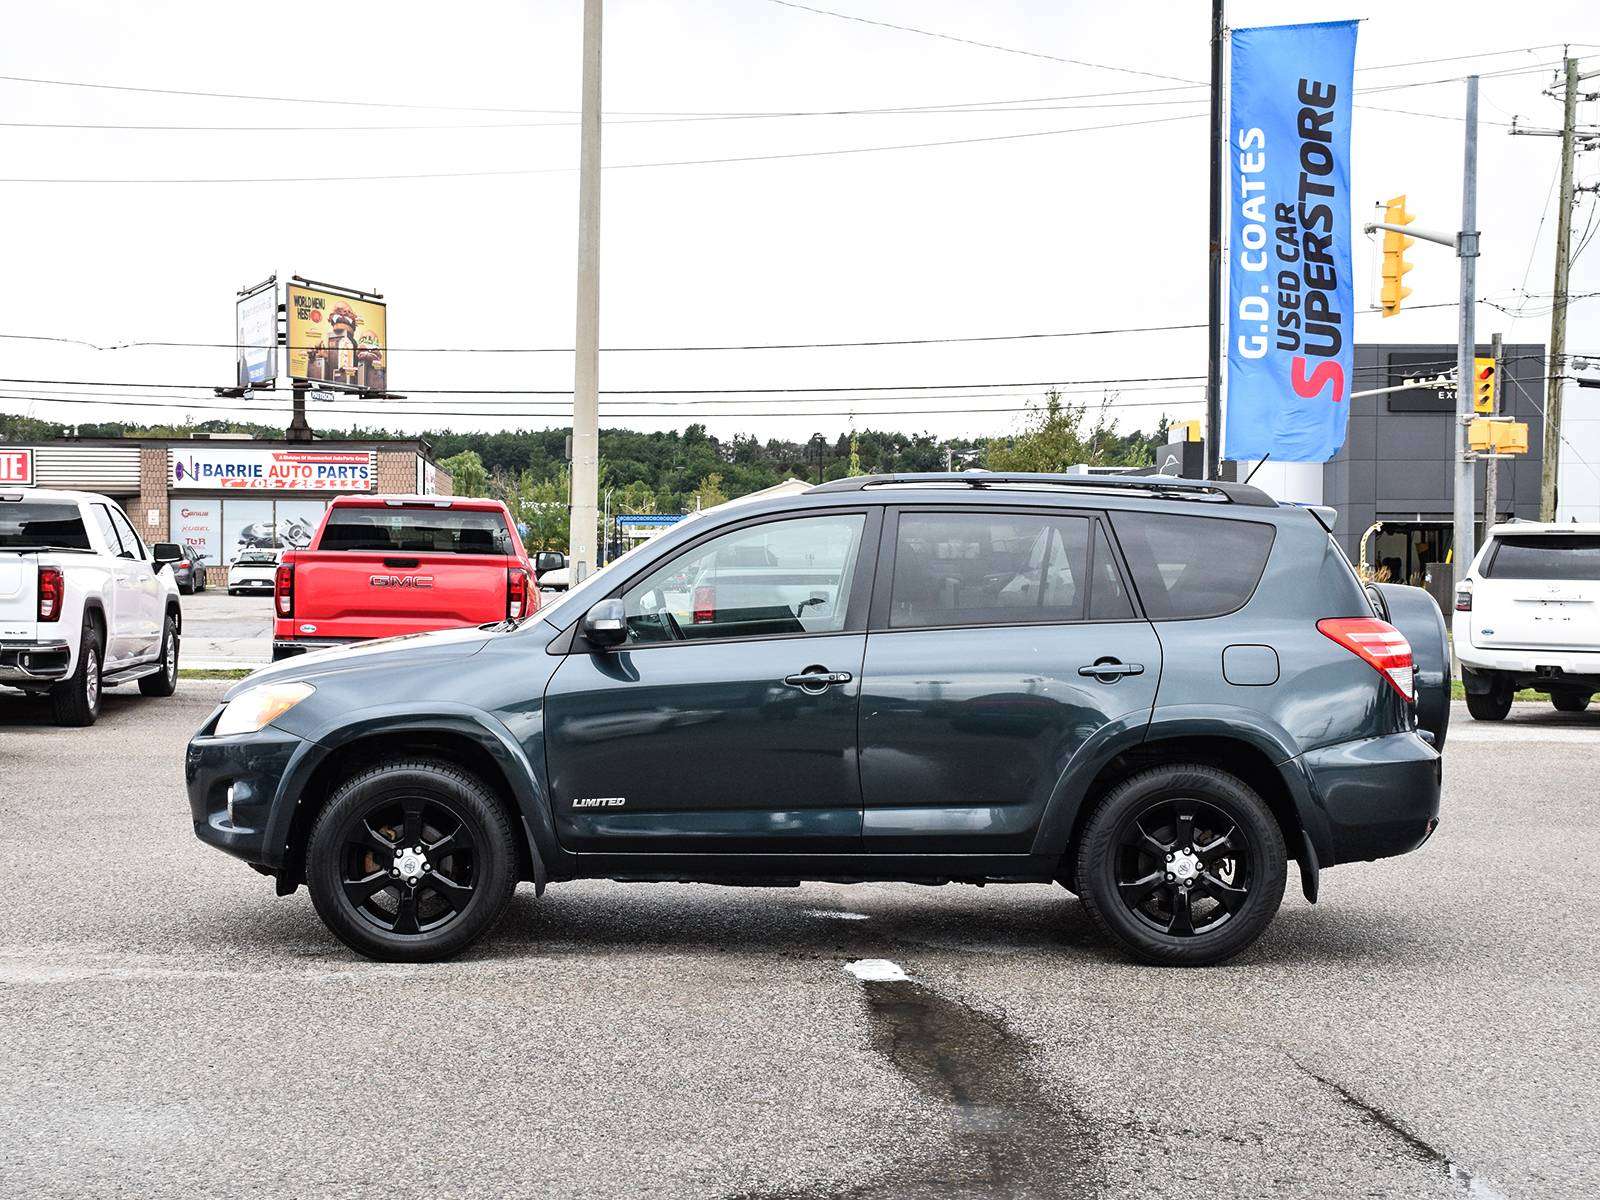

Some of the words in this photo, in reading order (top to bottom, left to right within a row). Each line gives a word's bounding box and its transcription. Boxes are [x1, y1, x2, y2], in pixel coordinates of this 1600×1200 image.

[1239, 127, 1268, 272] COATES
[1275, 202, 1300, 263] CAR
[1291, 78, 1345, 402] SUPERSTORE
[294, 295, 312, 308] WORLD
[312, 297, 326, 311] MENU
[1238, 284, 1269, 359] G.D.
[1276, 270, 1301, 351] USED
[203, 464, 262, 478] BARRIE
[269, 465, 313, 478] AUTO
[317, 466, 369, 479] PARTS
[370, 575, 434, 588] GMC
[572, 797, 626, 808] LIMITED
